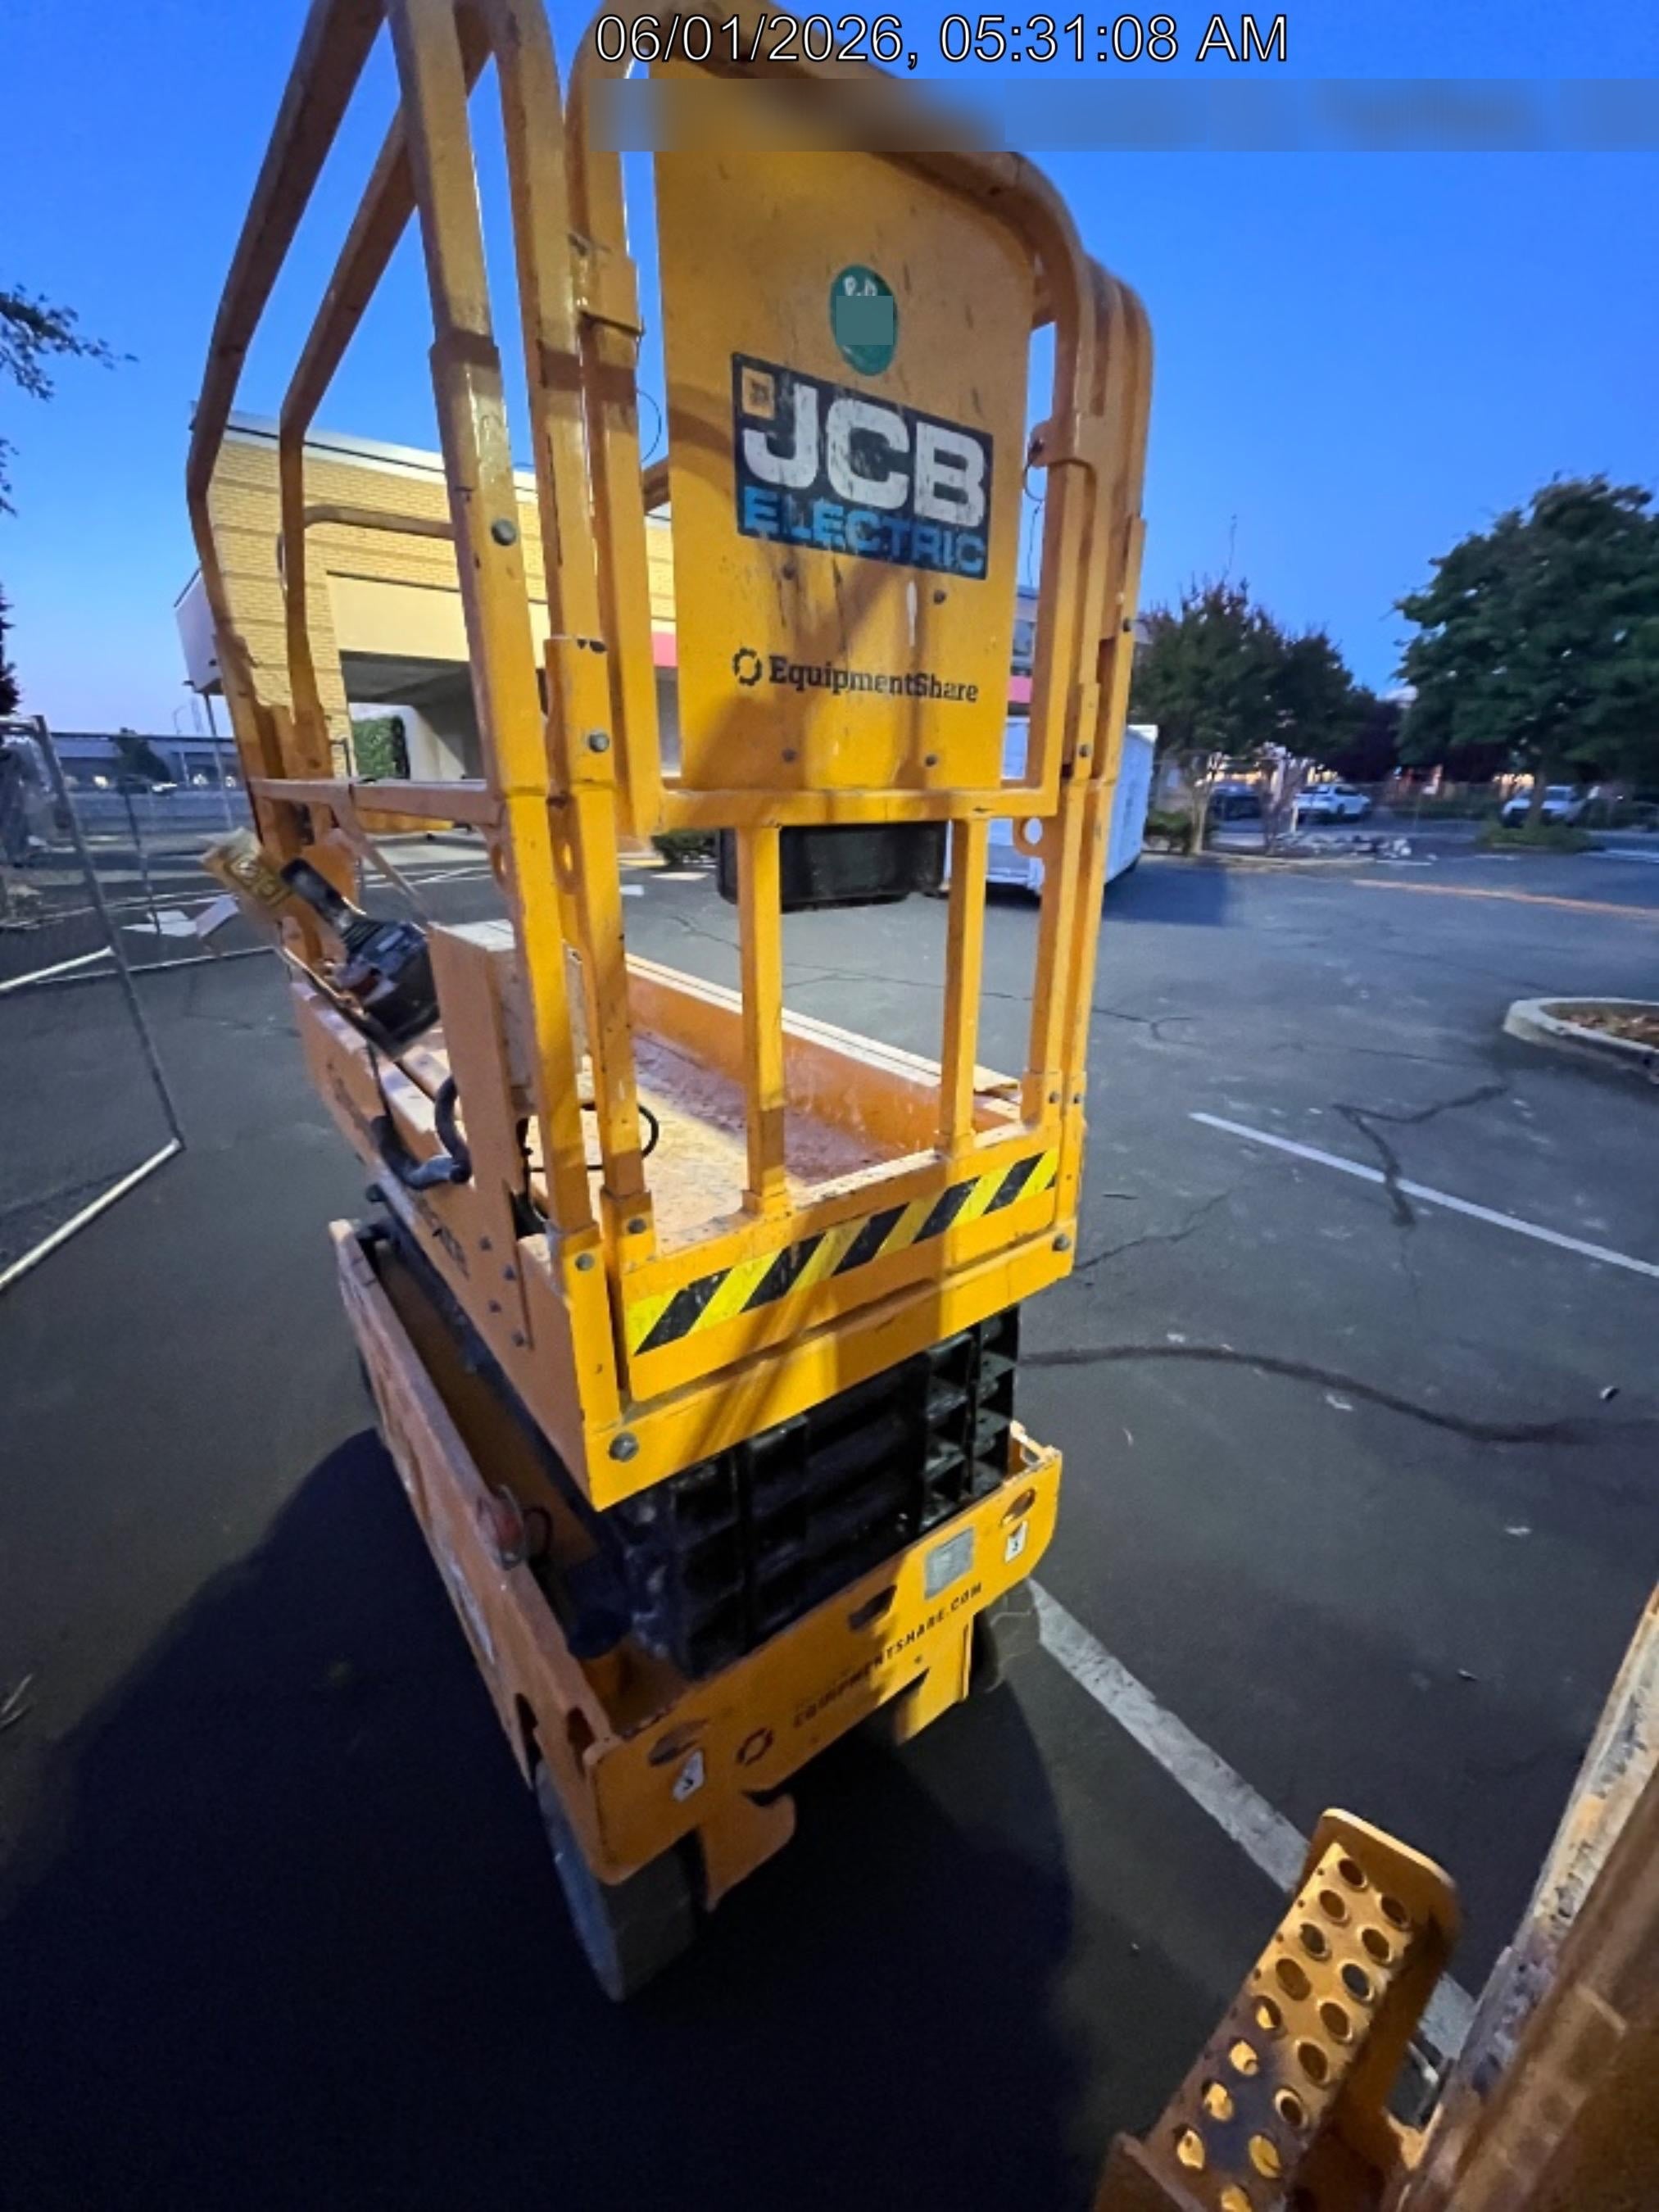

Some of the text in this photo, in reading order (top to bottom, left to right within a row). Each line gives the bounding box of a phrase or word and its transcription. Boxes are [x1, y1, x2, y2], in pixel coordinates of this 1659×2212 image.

[742, 381, 985, 528] JCB
[743, 487, 984, 572] ELECTRIC
[768, 654, 978, 703] EquipmentShare
